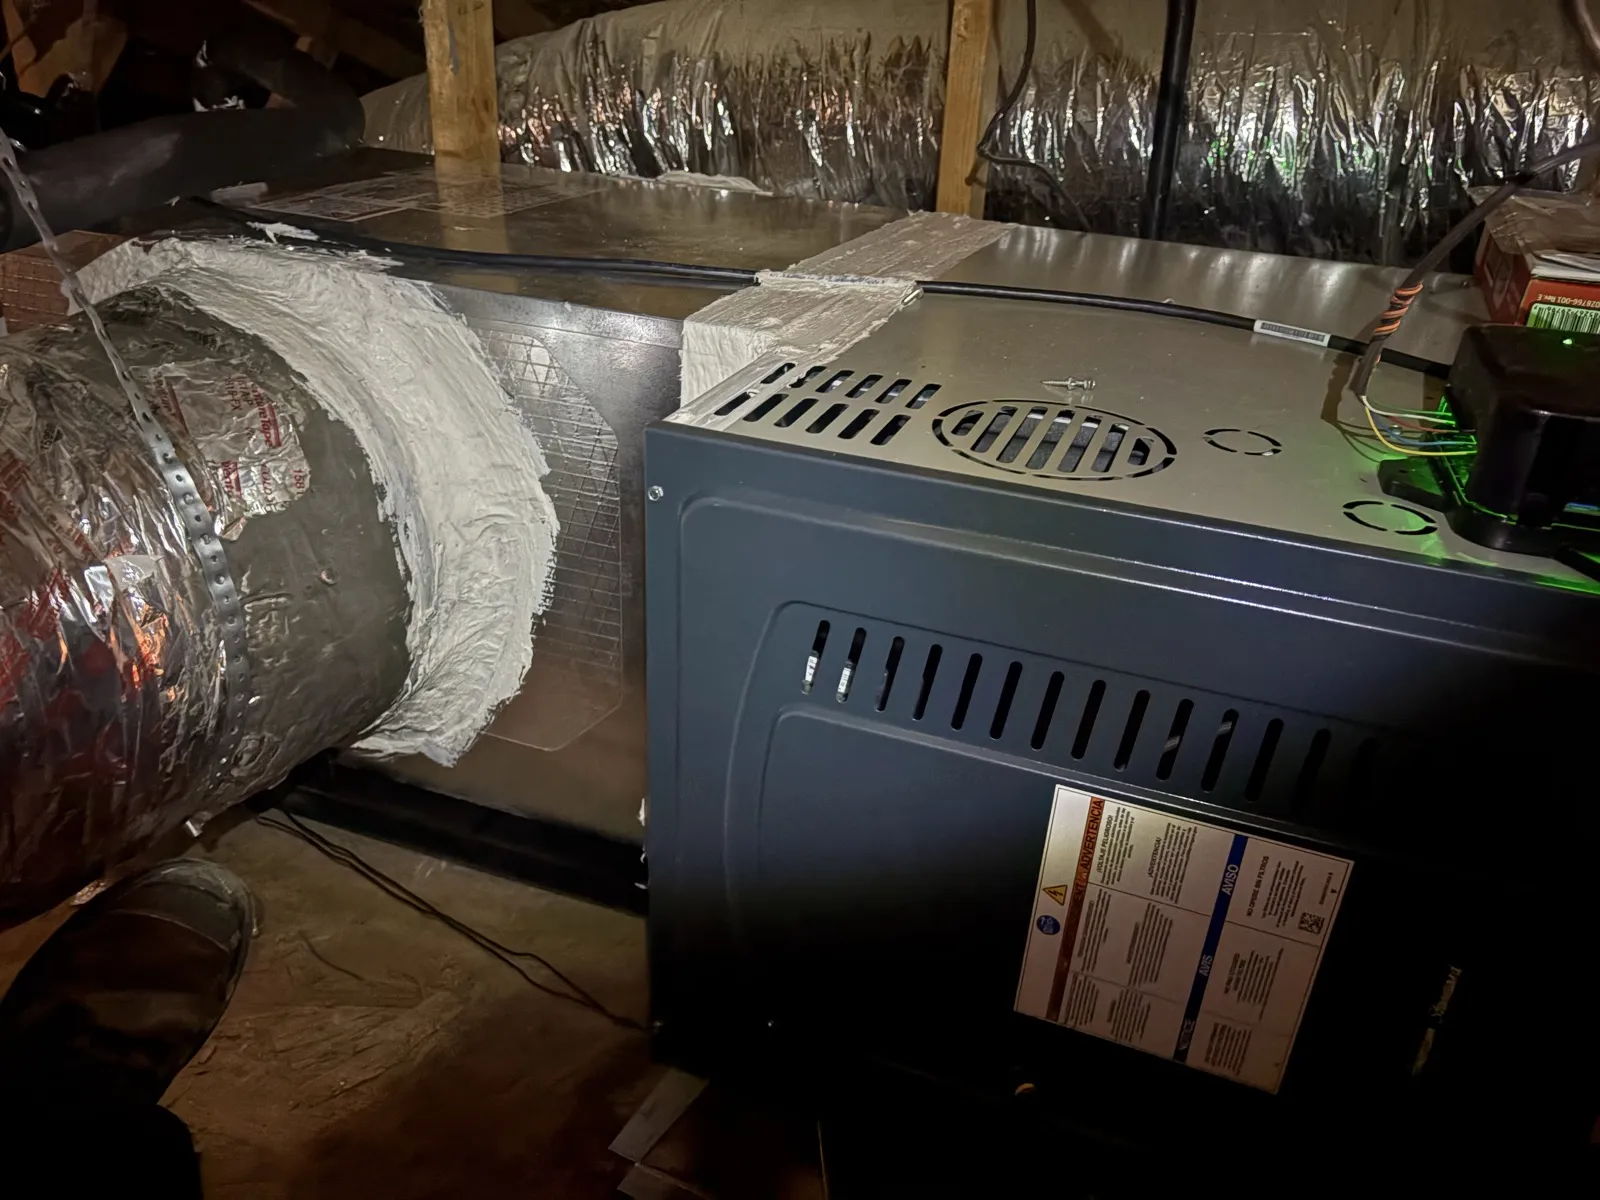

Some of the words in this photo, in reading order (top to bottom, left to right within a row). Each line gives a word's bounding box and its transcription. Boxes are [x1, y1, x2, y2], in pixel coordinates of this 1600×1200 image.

[1079, 798, 1103, 870] ADVERTENCIA
[1221, 864, 1239, 895] AVISO
[1199, 955, 1213, 976] AVIS
